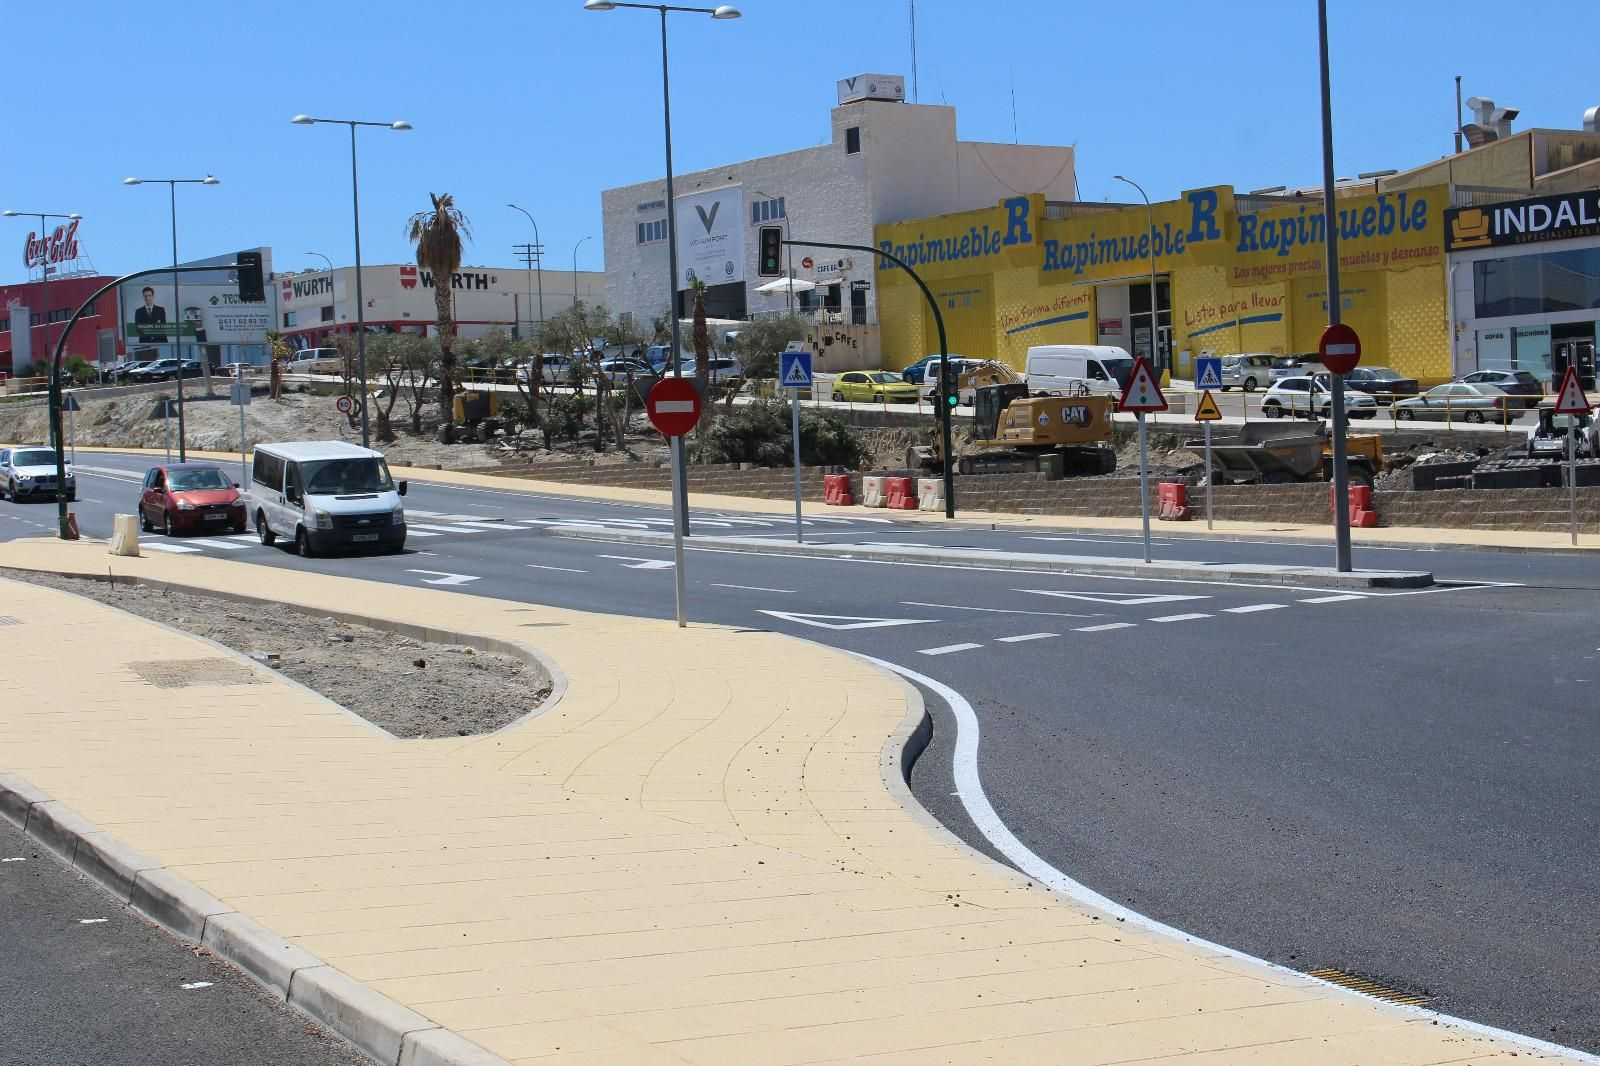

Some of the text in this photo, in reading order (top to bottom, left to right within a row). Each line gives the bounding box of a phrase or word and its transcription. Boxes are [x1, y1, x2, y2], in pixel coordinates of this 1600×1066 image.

[1003, 197, 1033, 246] R
[1186, 190, 1221, 243] R
[1236, 192, 1428, 256] Rapimueble
[1494, 198, 1600, 235] INDAL
[879, 225, 1000, 271] Rapimueble
[1043, 223, 1185, 275] Rapimueble
[1234, 245, 1439, 279] Los mejores precios muebles y descanso
[293, 276, 333, 298] WÜRTH
[419, 271, 488, 290] WRTH
[1220, 301, 1248, 318] para
[1251, 291, 1285, 308] llevar
[1061, 406, 1086, 424] CAT
